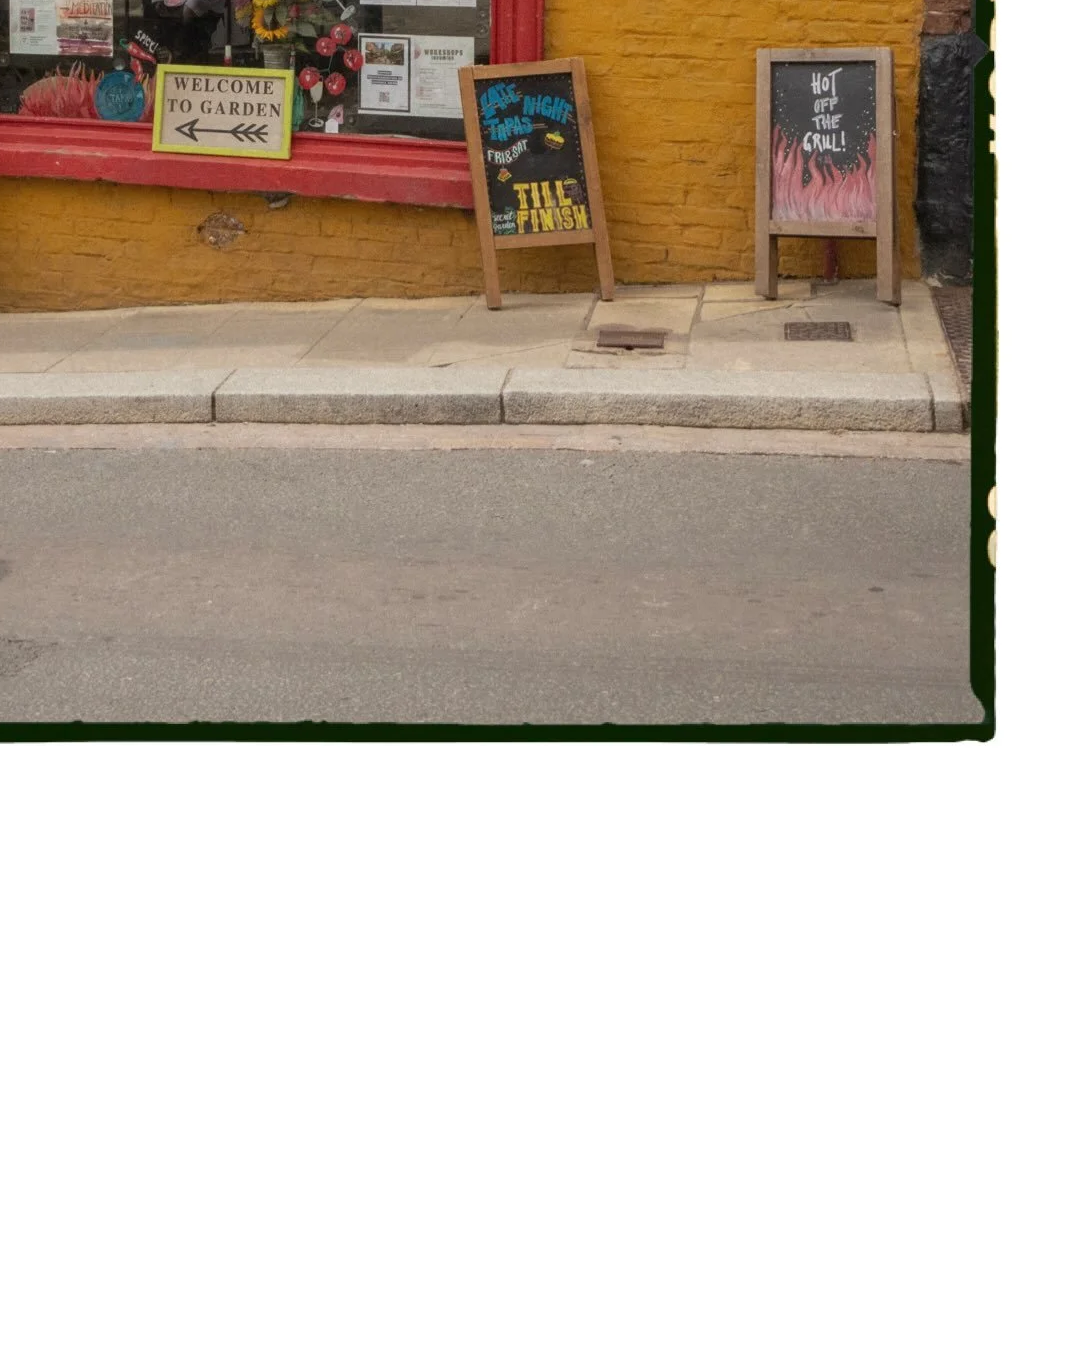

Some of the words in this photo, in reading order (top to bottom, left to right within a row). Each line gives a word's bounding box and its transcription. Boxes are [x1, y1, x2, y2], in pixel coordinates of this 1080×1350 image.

[174, 76, 274, 95] WELCOME
[810, 67, 843, 96] HOT
[168, 98, 192, 113] TO
[201, 99, 282, 118] GARDEN
[480, 82, 521, 120] LATE
[523, 94, 574, 125] NIGHT
[814, 96, 838, 114] OFF
[483, 115, 534, 141] TAPAS
[812, 113, 843, 130] THE
[802, 131, 846, 152] GRILL!
[513, 179, 572, 210] TILL
[516, 204, 590, 234] FINISH
